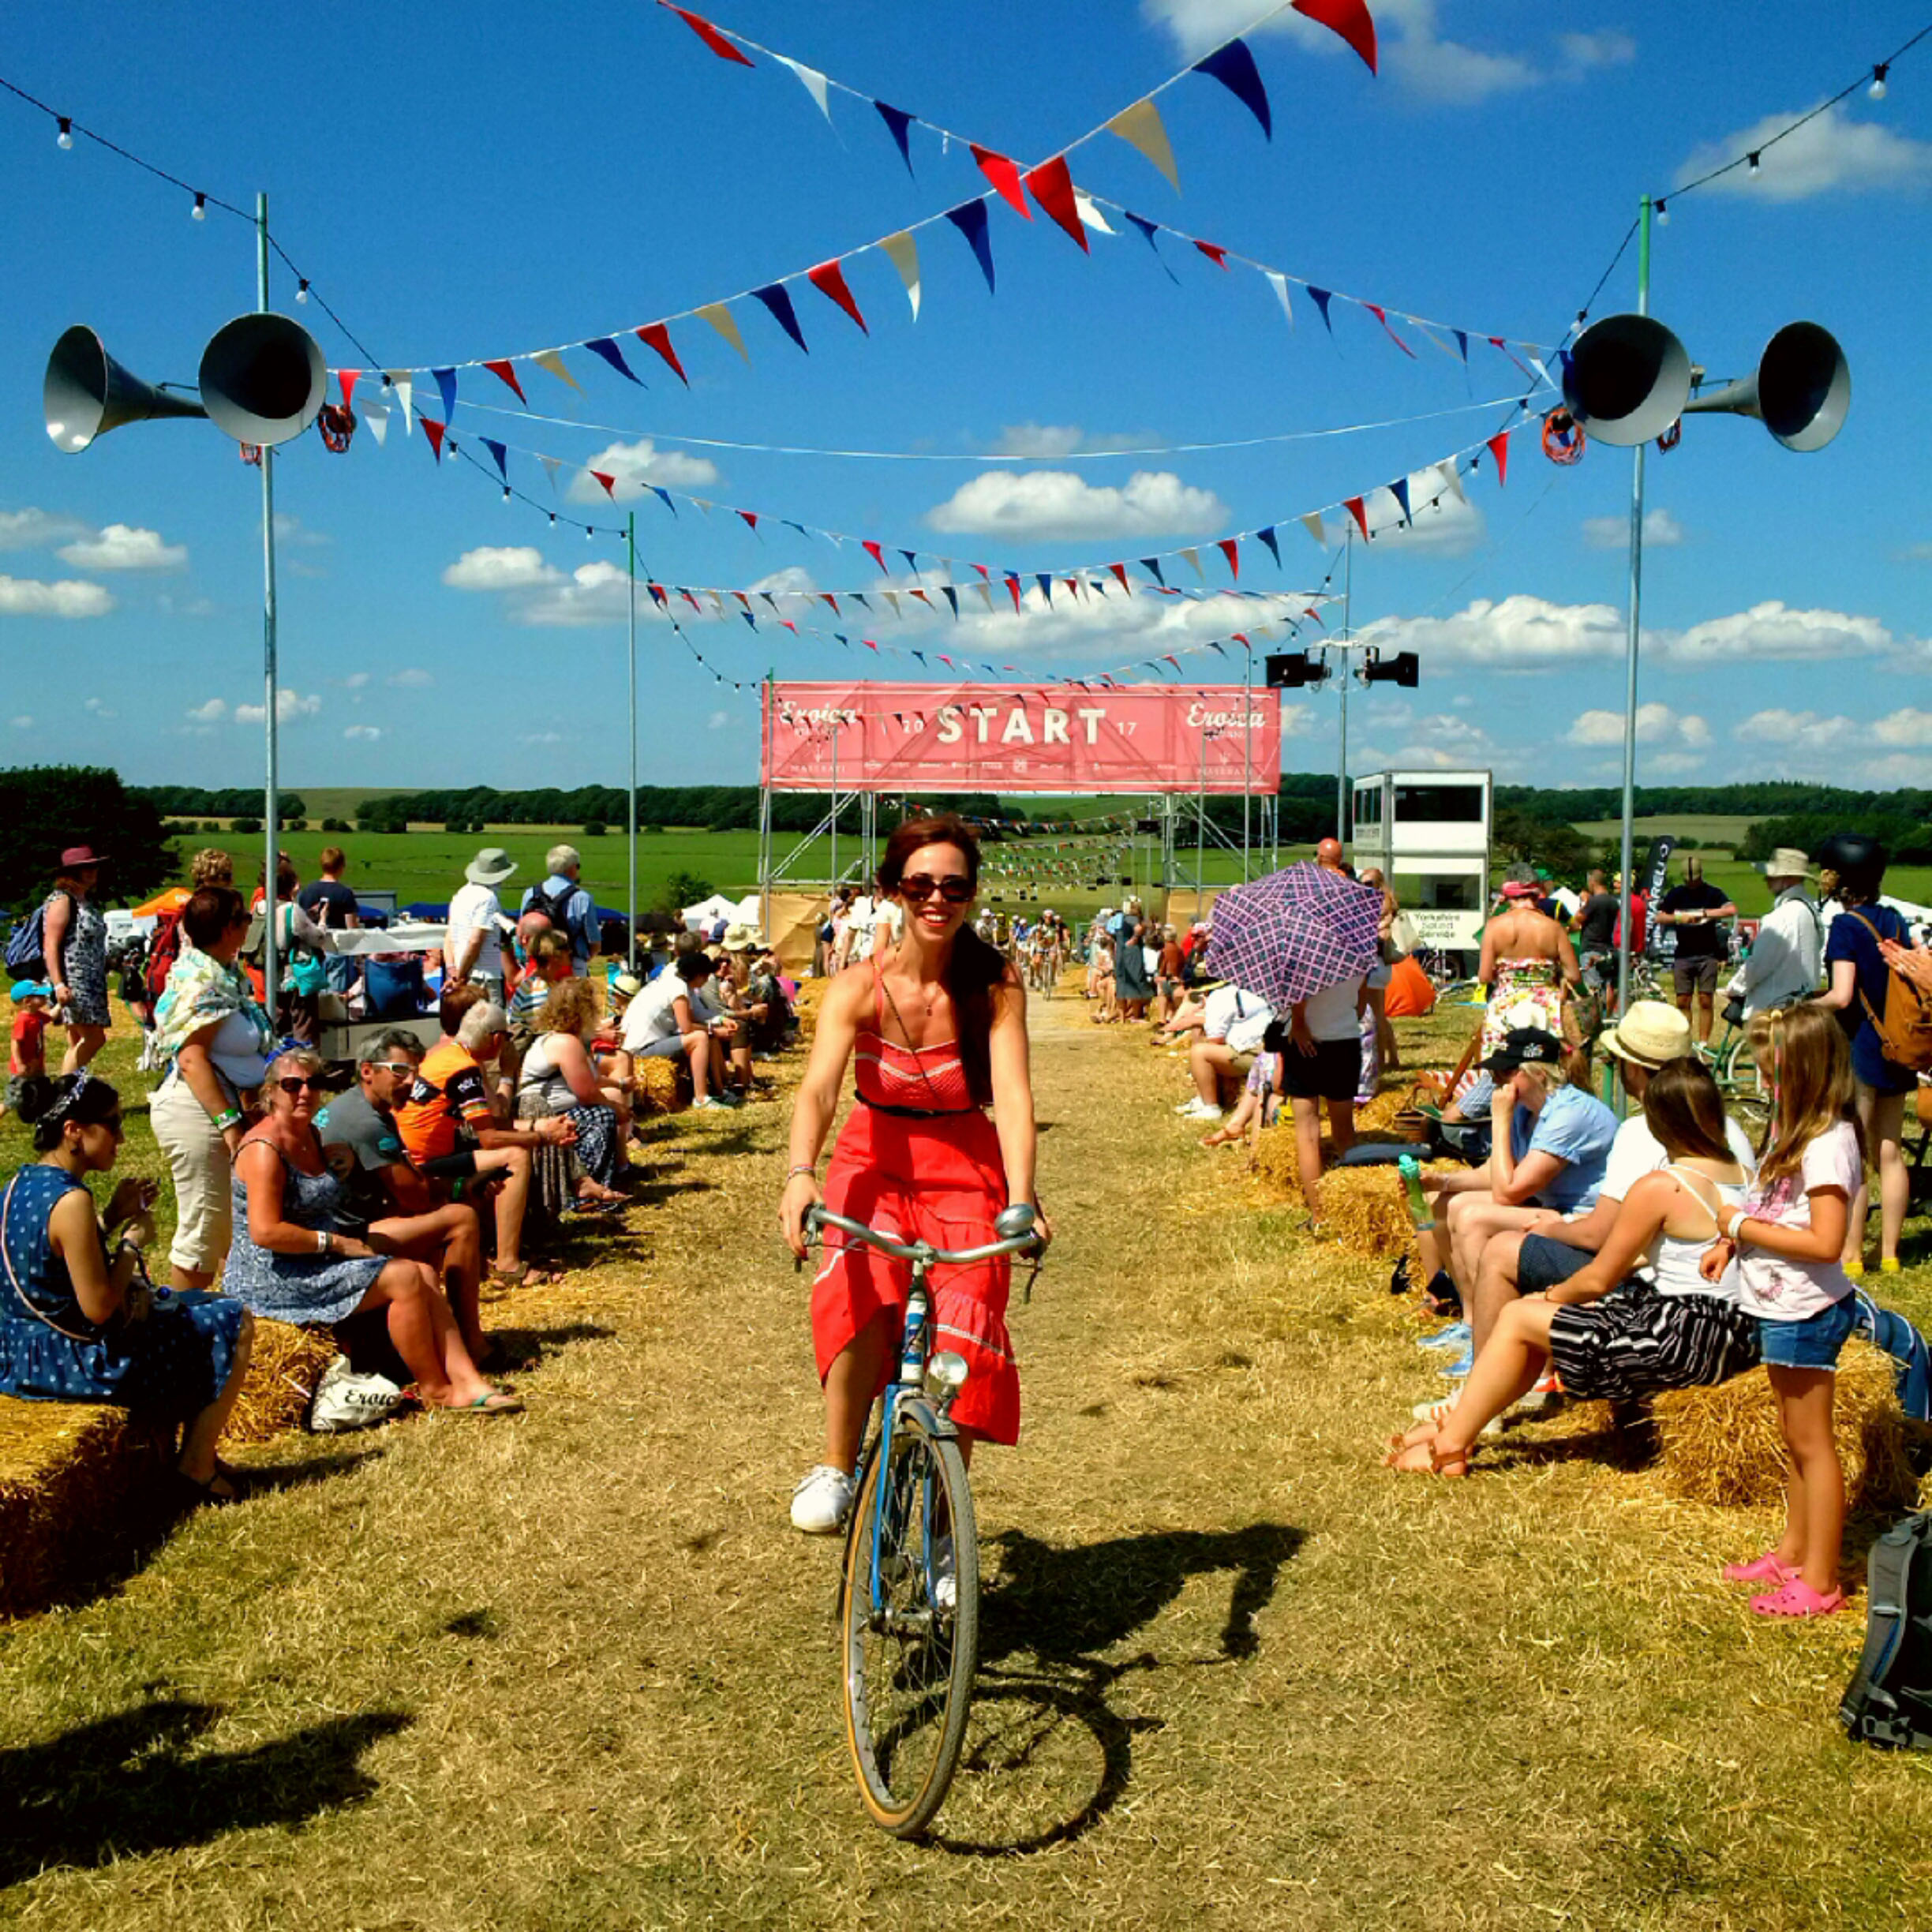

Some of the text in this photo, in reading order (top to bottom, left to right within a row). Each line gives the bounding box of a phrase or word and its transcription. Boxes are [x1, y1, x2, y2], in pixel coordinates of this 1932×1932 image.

[779, 701, 859, 724] Eroica
[902, 707, 1137, 744] 20 START 17
[1186, 702, 1266, 728] Eroica
